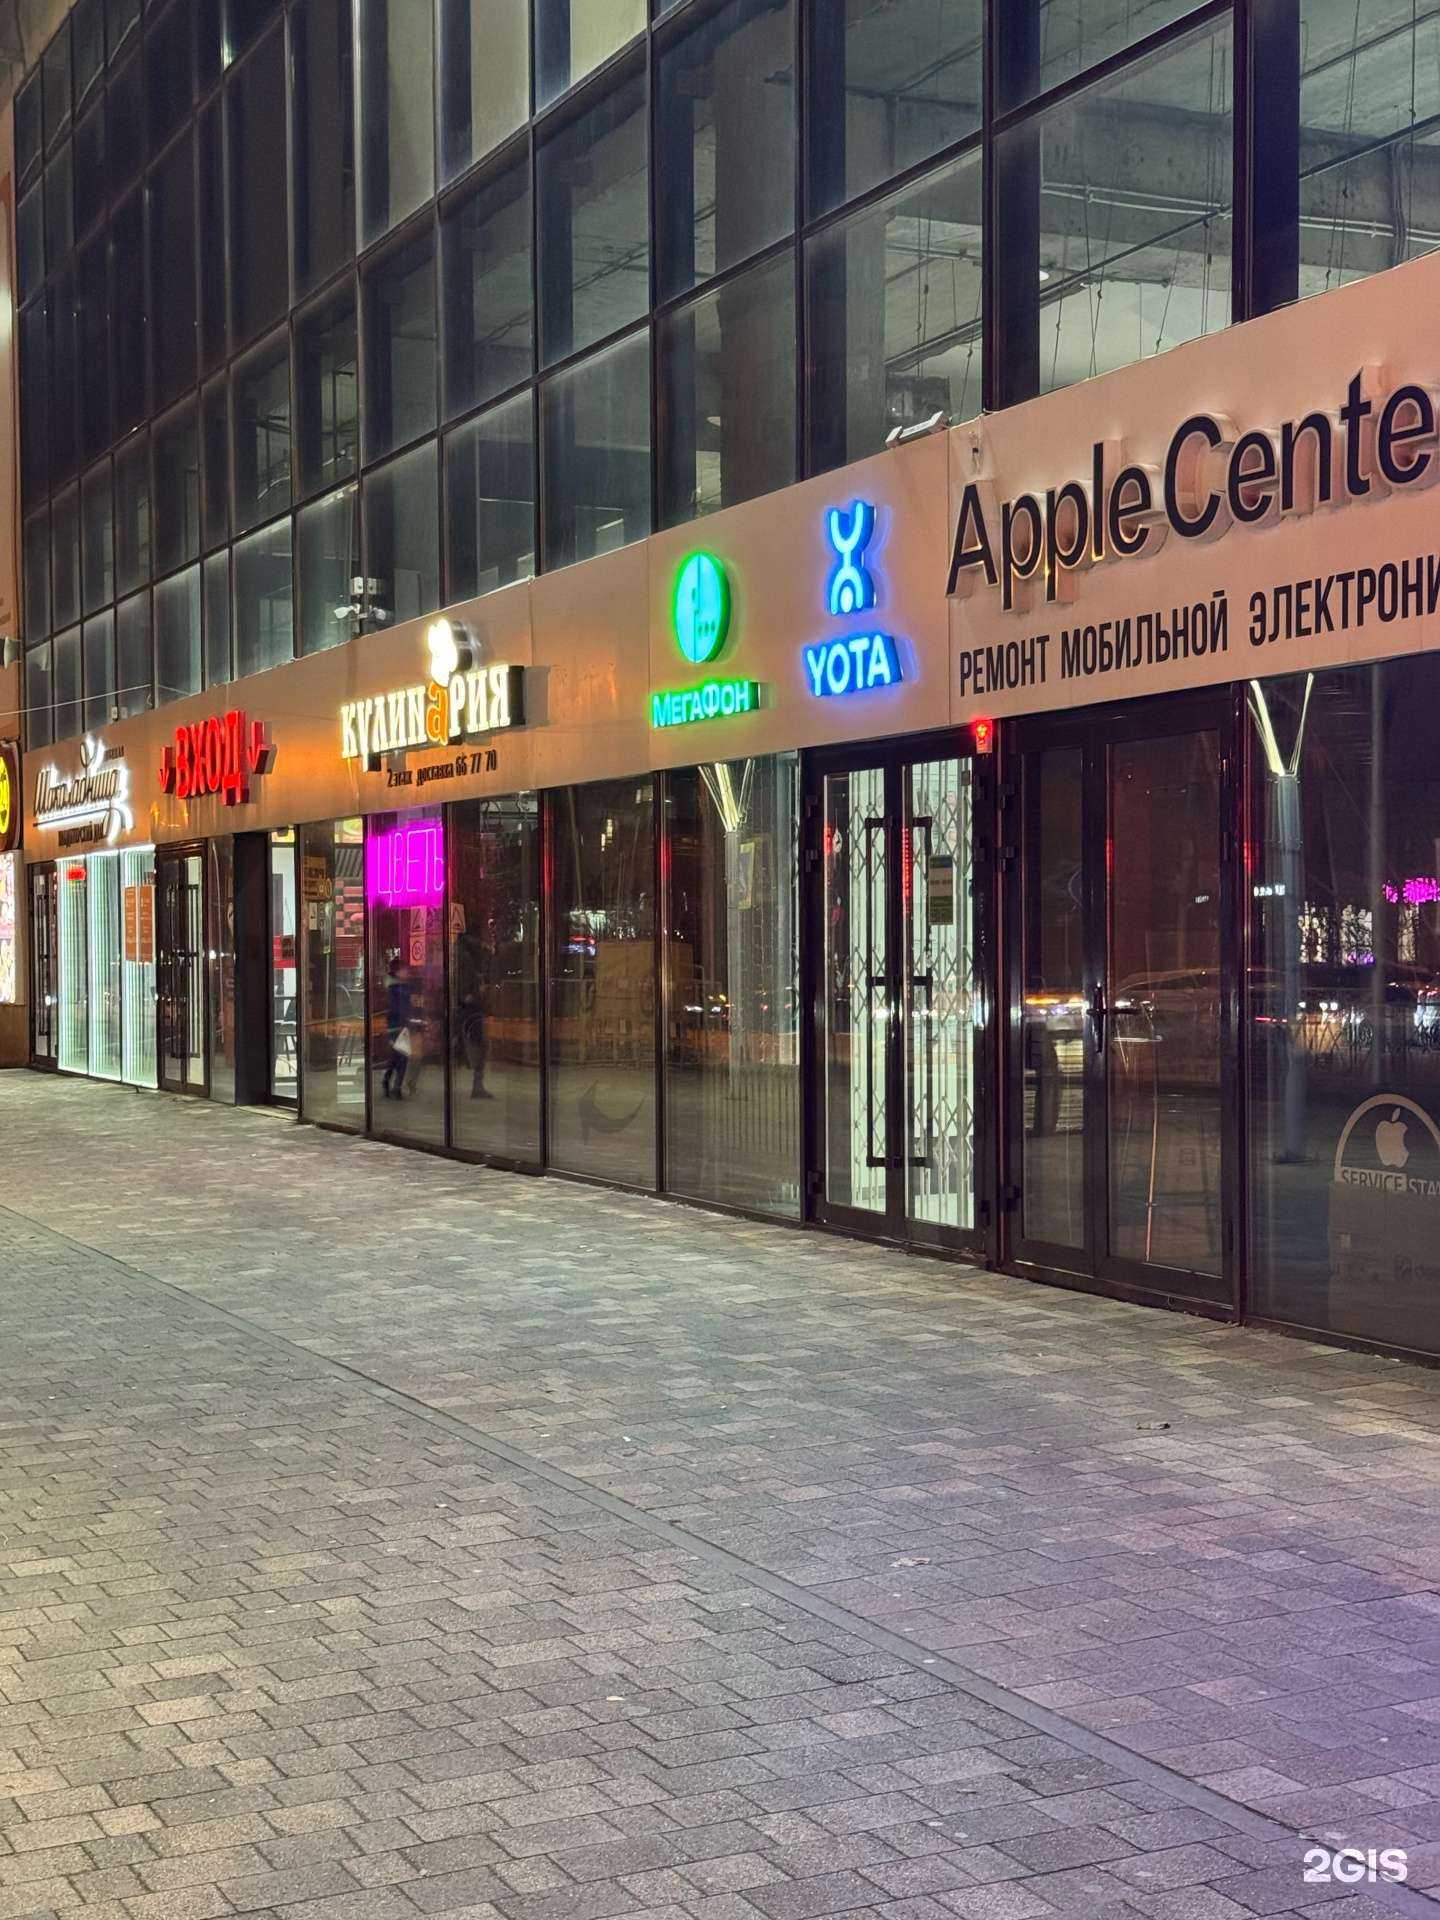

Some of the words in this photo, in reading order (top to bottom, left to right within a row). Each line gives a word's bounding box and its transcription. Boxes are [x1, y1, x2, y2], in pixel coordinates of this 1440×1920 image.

[807, 635, 891, 697] YOTA
[960, 634, 1050, 697] РЕМОНТ
[1061, 590, 1229, 680] МОБИЛЬНОЙ
[175, 711, 243, 806] ВХОД
